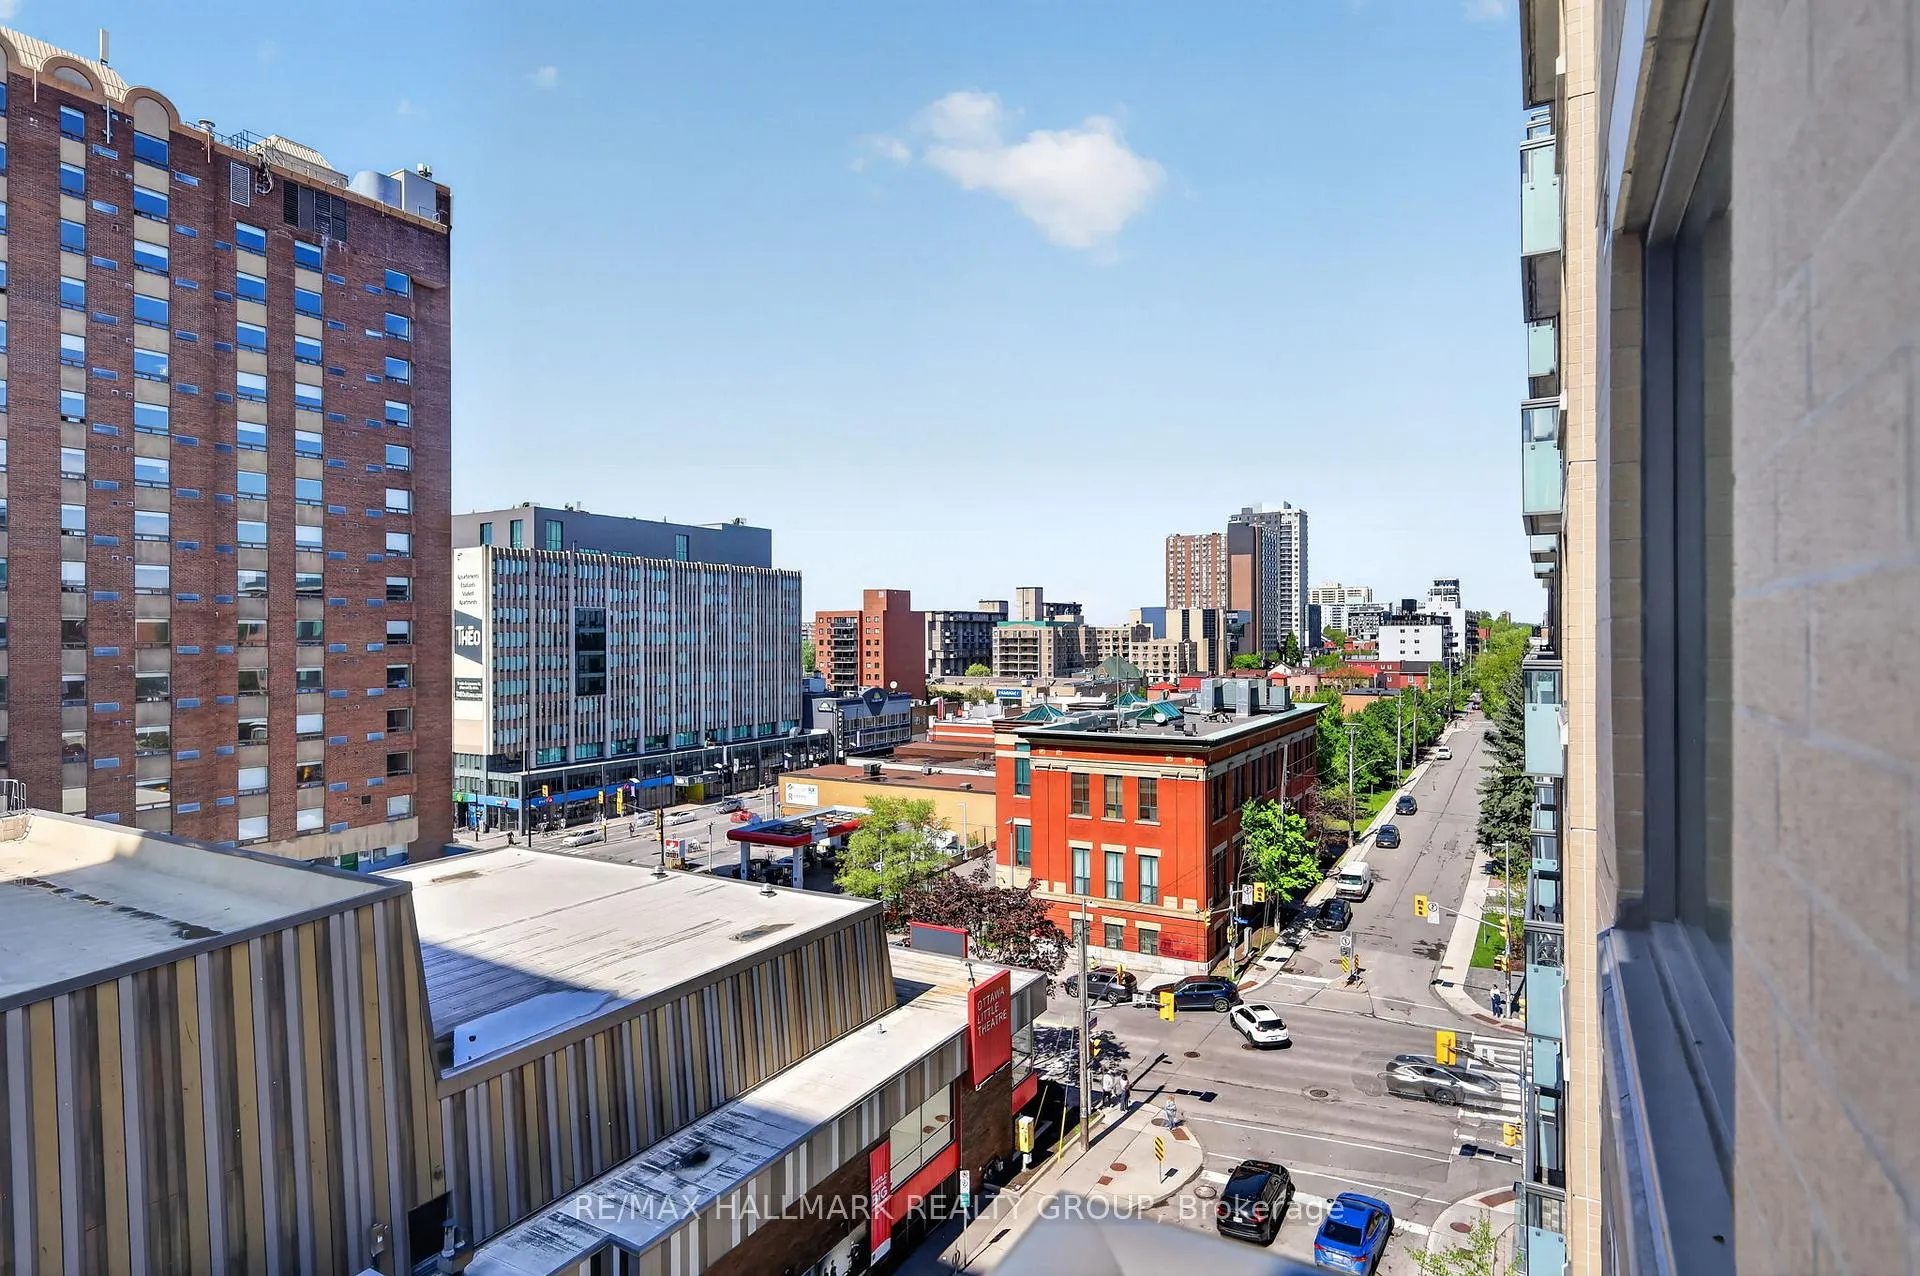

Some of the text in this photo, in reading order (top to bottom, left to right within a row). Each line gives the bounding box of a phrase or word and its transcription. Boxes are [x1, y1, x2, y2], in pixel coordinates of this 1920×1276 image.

[977, 986, 1005, 1011] OTTAWA
[977, 1002, 1000, 1025] LITTLE
[977, 1008, 1008, 1037] THEATRE
[872, 1185, 888, 1208] BIG
